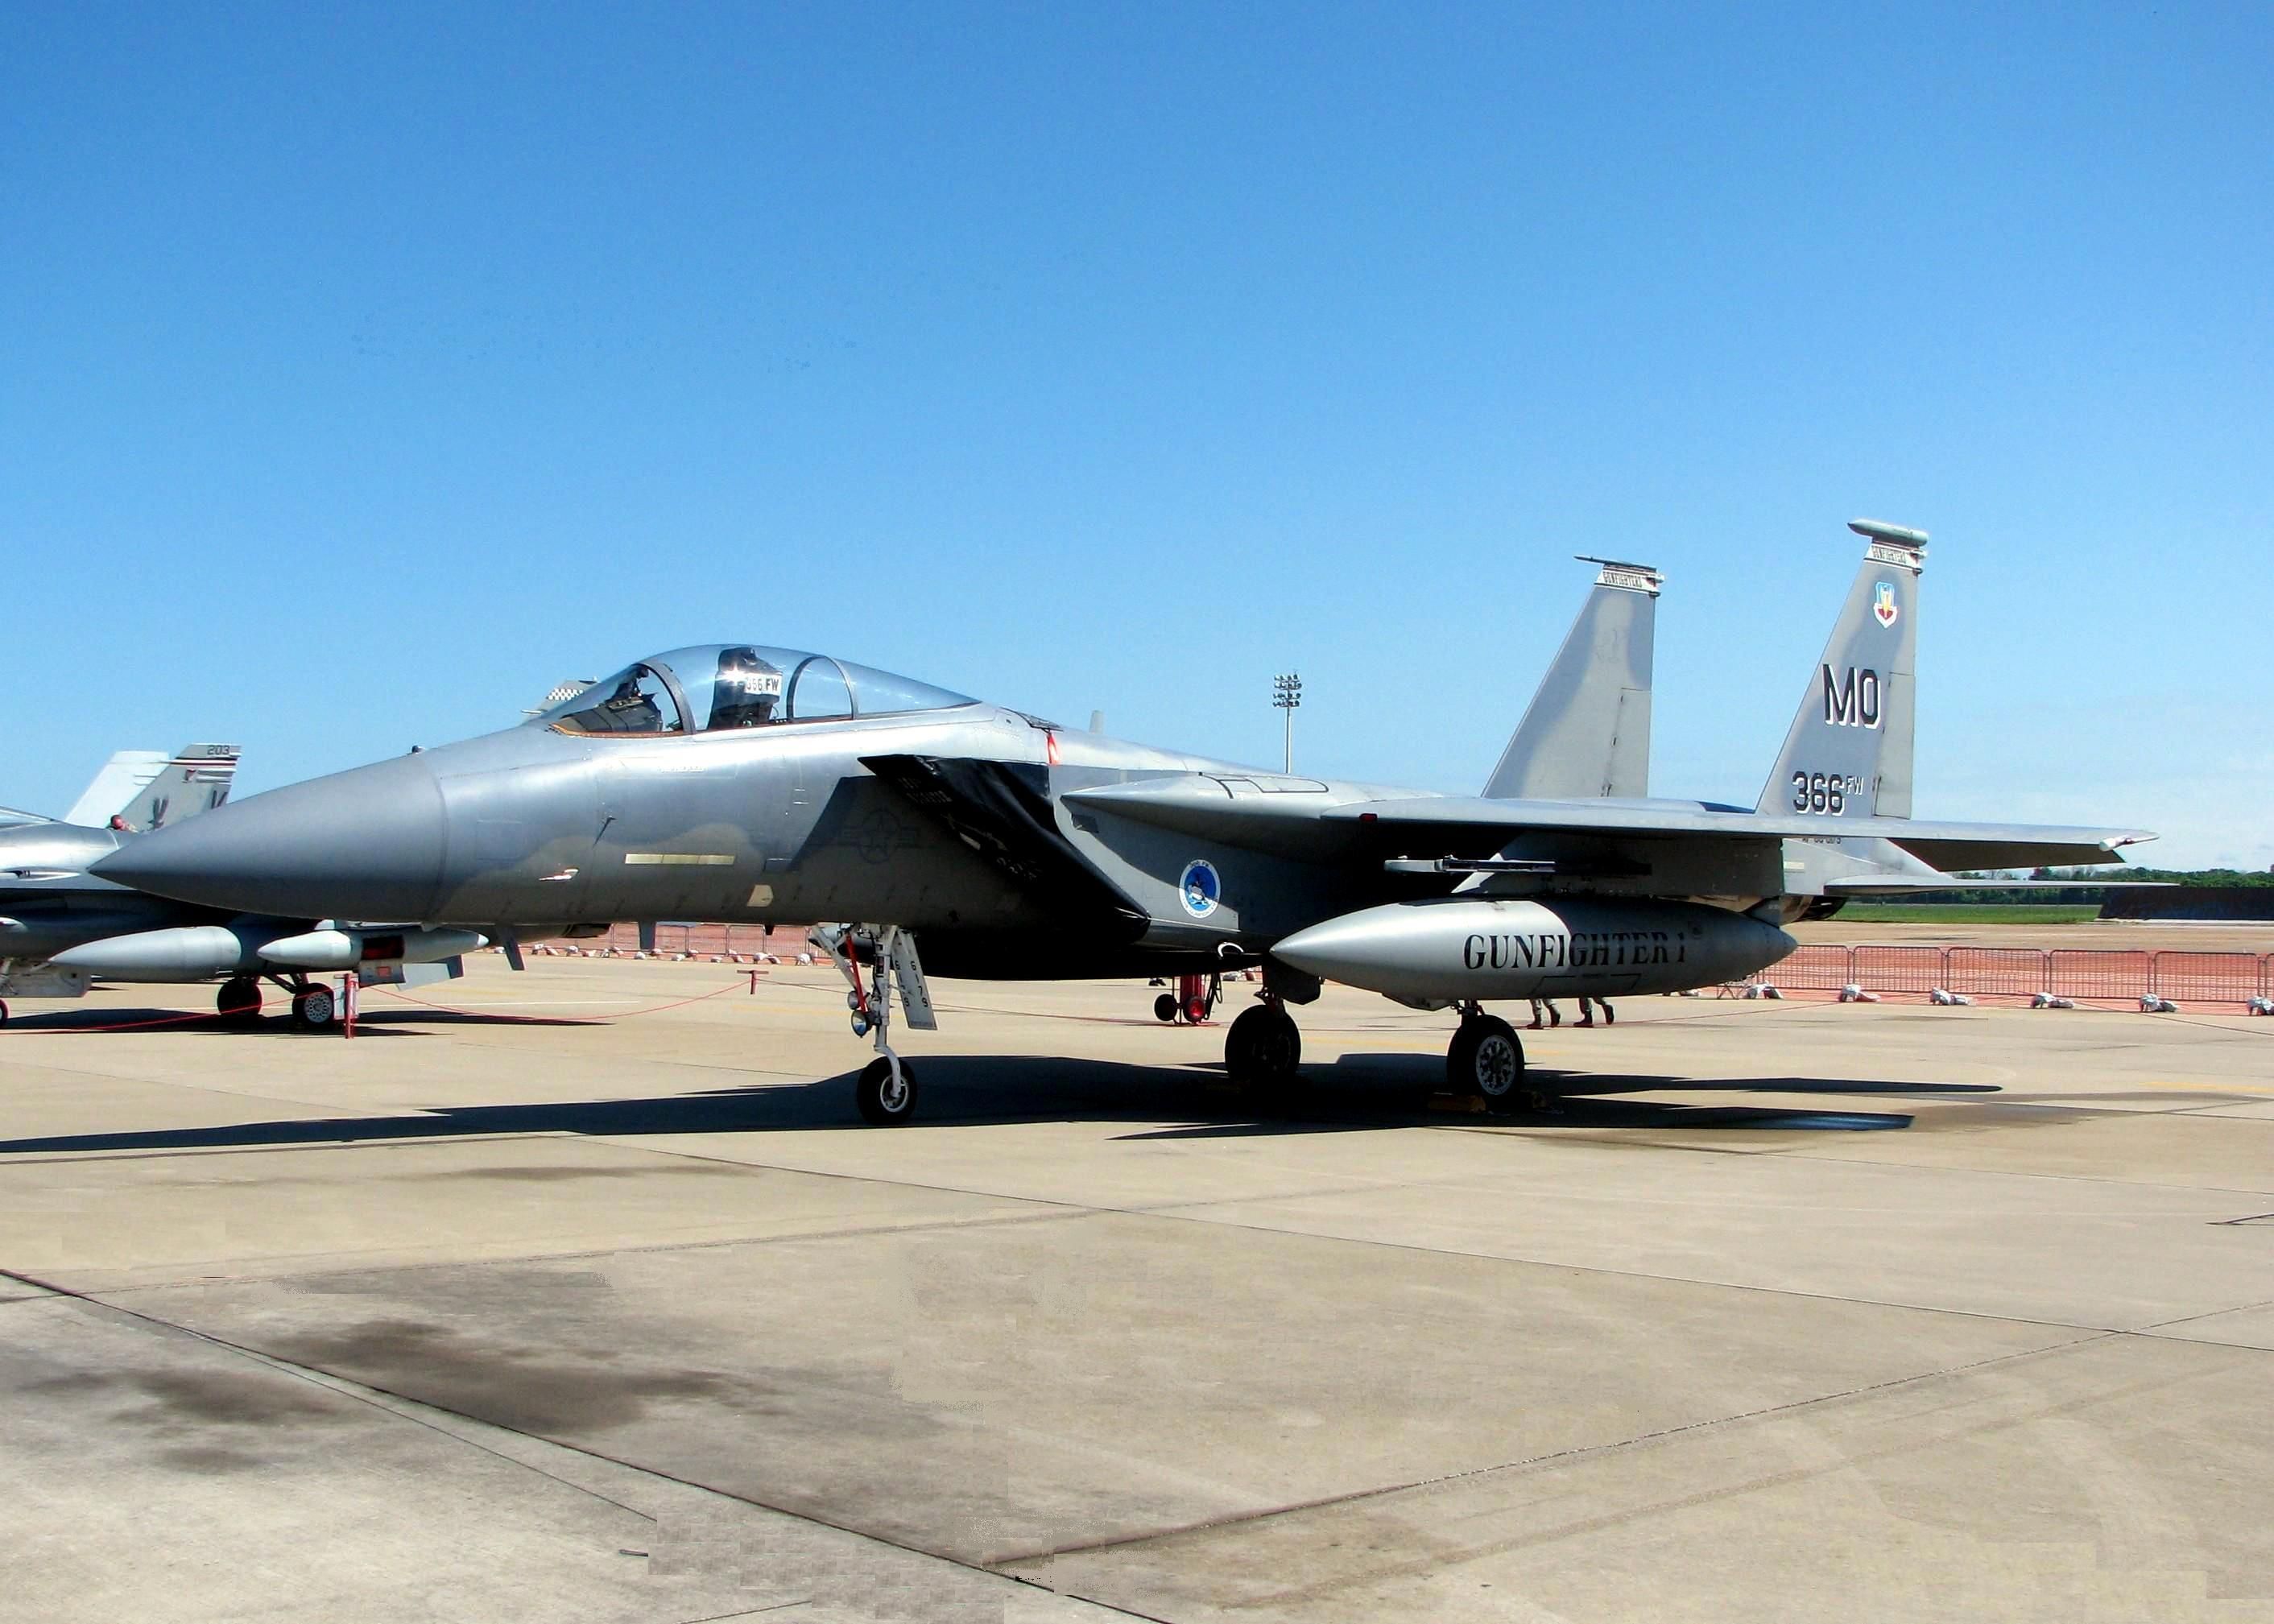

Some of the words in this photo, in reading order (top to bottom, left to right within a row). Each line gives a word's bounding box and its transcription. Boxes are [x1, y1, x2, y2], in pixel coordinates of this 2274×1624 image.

[766, 678, 779, 692] FW
[1822, 663, 1881, 730] MO
[207, 745, 230, 755] 203
[1792, 771, 1846, 816] 366
[1846, 775, 1864, 795] FW
[1463, 931, 1670, 969] GUNFIGHTER
